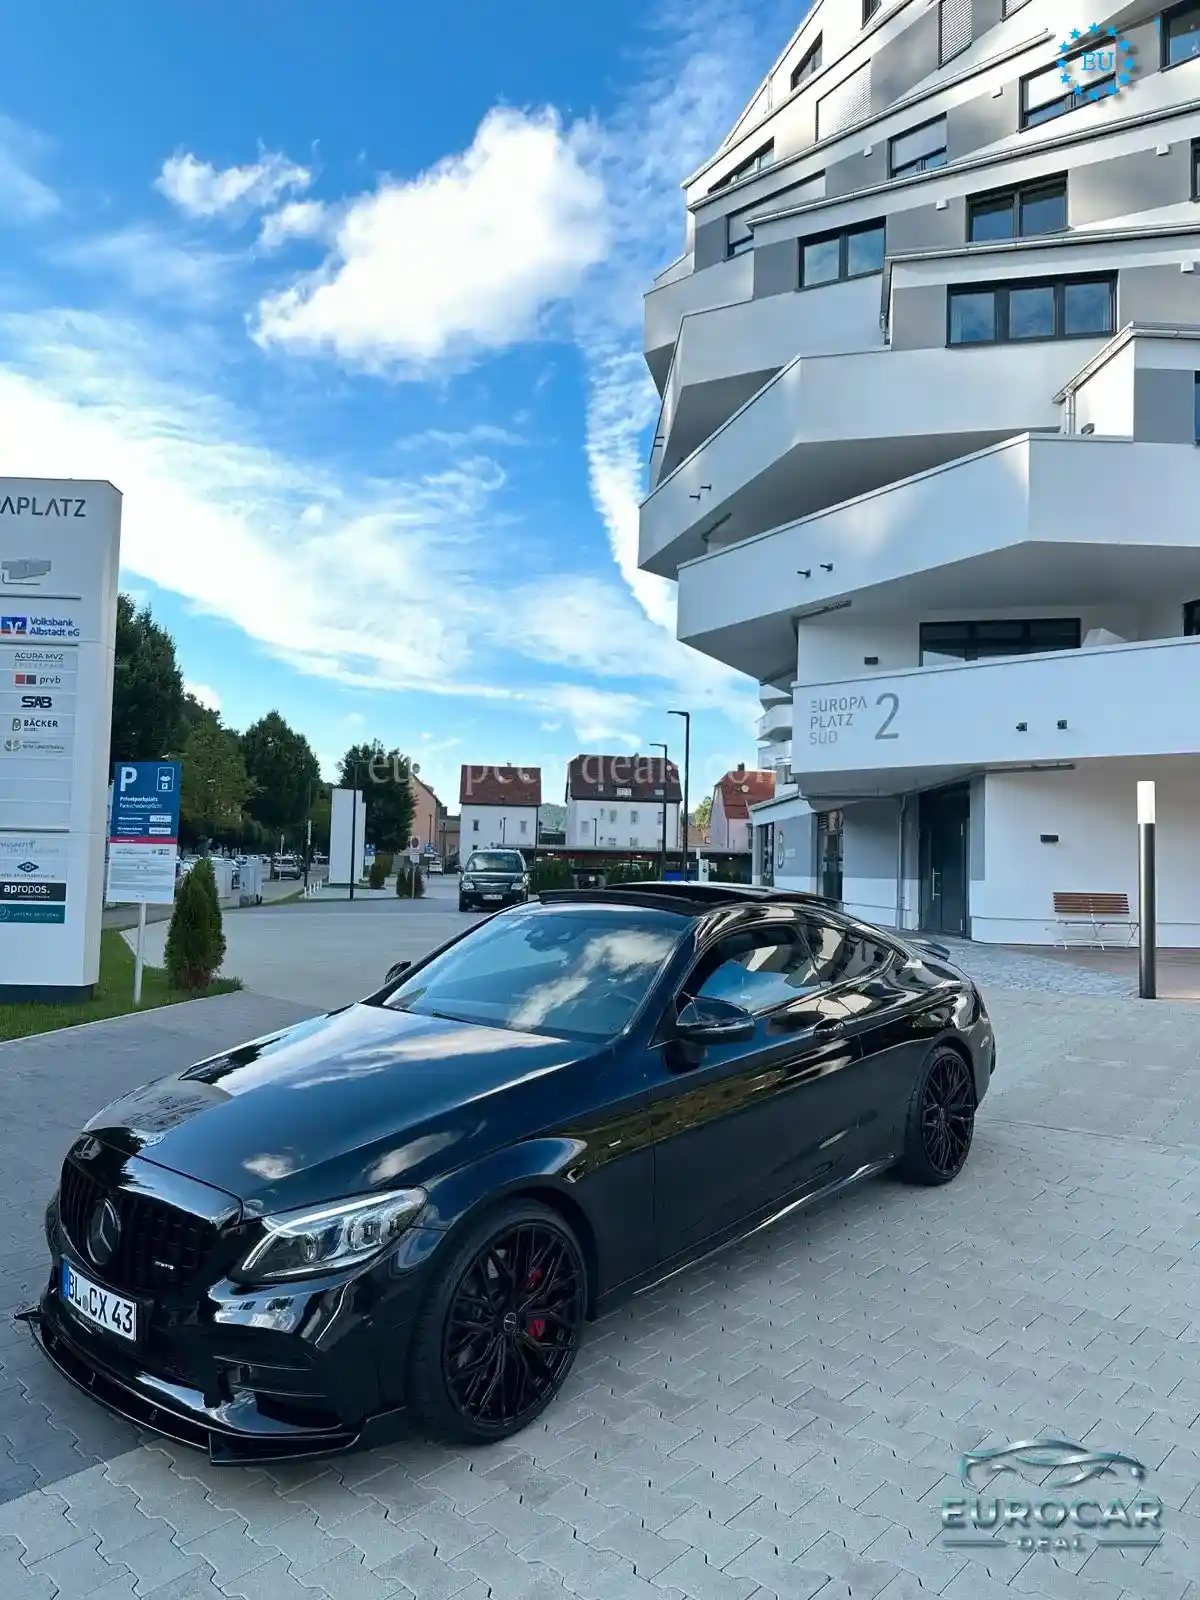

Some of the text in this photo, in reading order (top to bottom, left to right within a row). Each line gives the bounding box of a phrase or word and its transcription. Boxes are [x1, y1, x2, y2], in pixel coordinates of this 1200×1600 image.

[30, 617, 73, 627] Volksbank
[30, 627, 80, 637] Albstadt eG
[40, 675, 61, 684] prvb
[21, 695, 53, 709] SAB
[810, 692, 900, 740] EUROPA 2
[810, 713, 853, 729] PLATZ
[120, 766, 138, 792] P
[69, 1273, 82, 1308] BL
[89, 1286, 108, 1324] CX
[112, 1300, 133, 1335] 43
